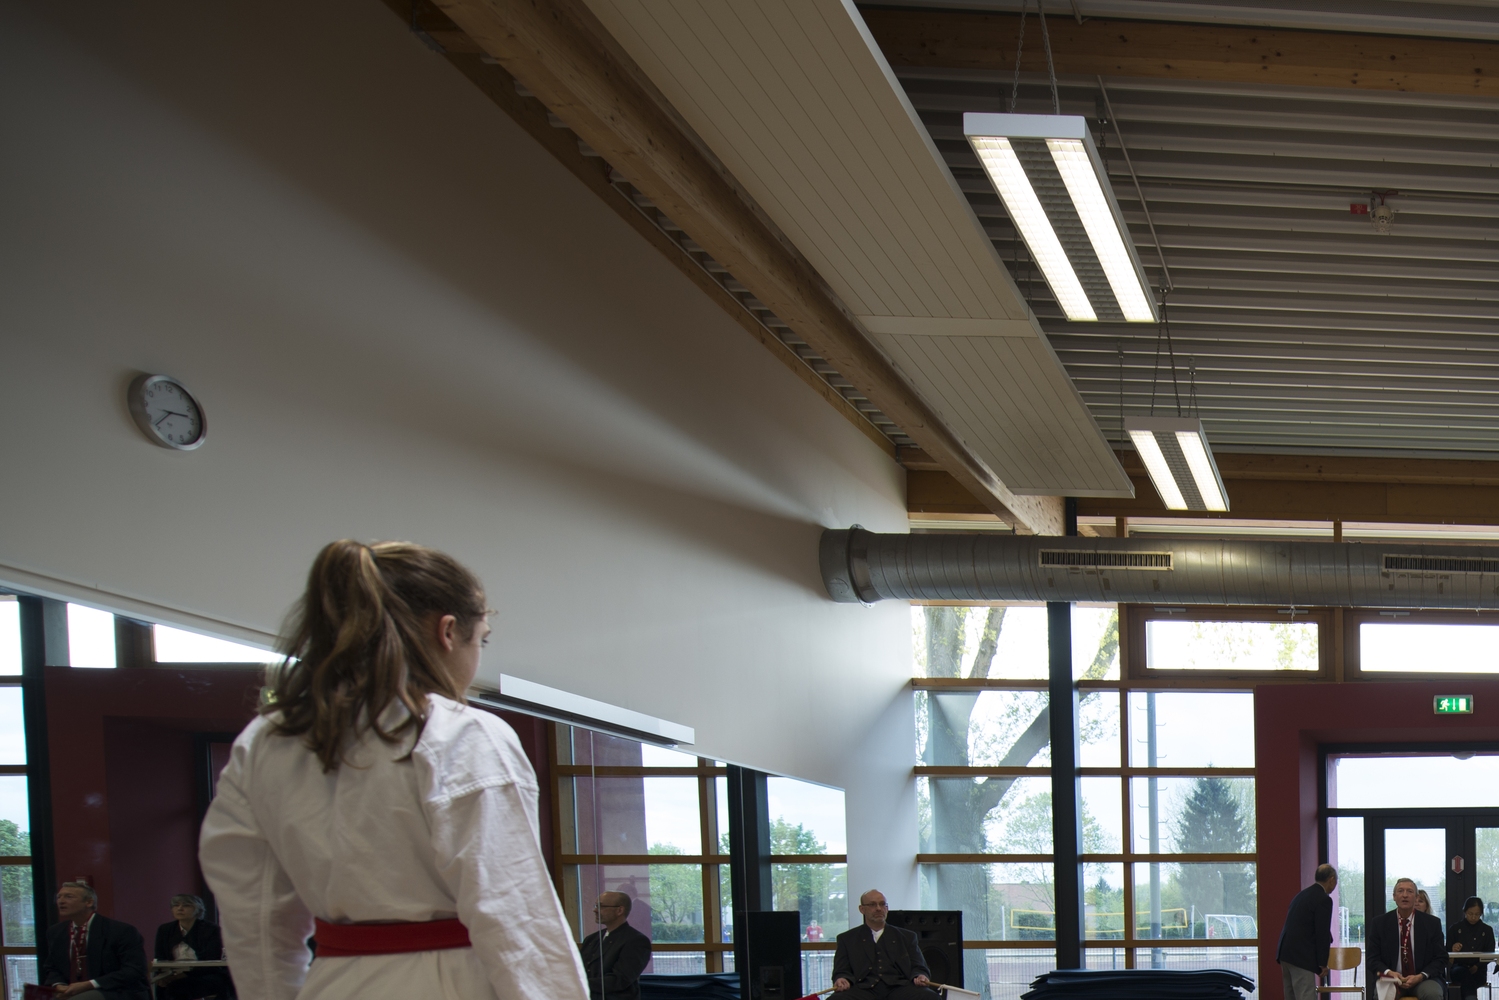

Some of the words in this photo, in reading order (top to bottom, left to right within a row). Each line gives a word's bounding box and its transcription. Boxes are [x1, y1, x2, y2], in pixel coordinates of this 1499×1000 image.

[153, 383, 161, 392] 11
[164, 384, 173, 394] 12
[145, 389, 154, 398] 10
[167, 433, 173, 441] 6
